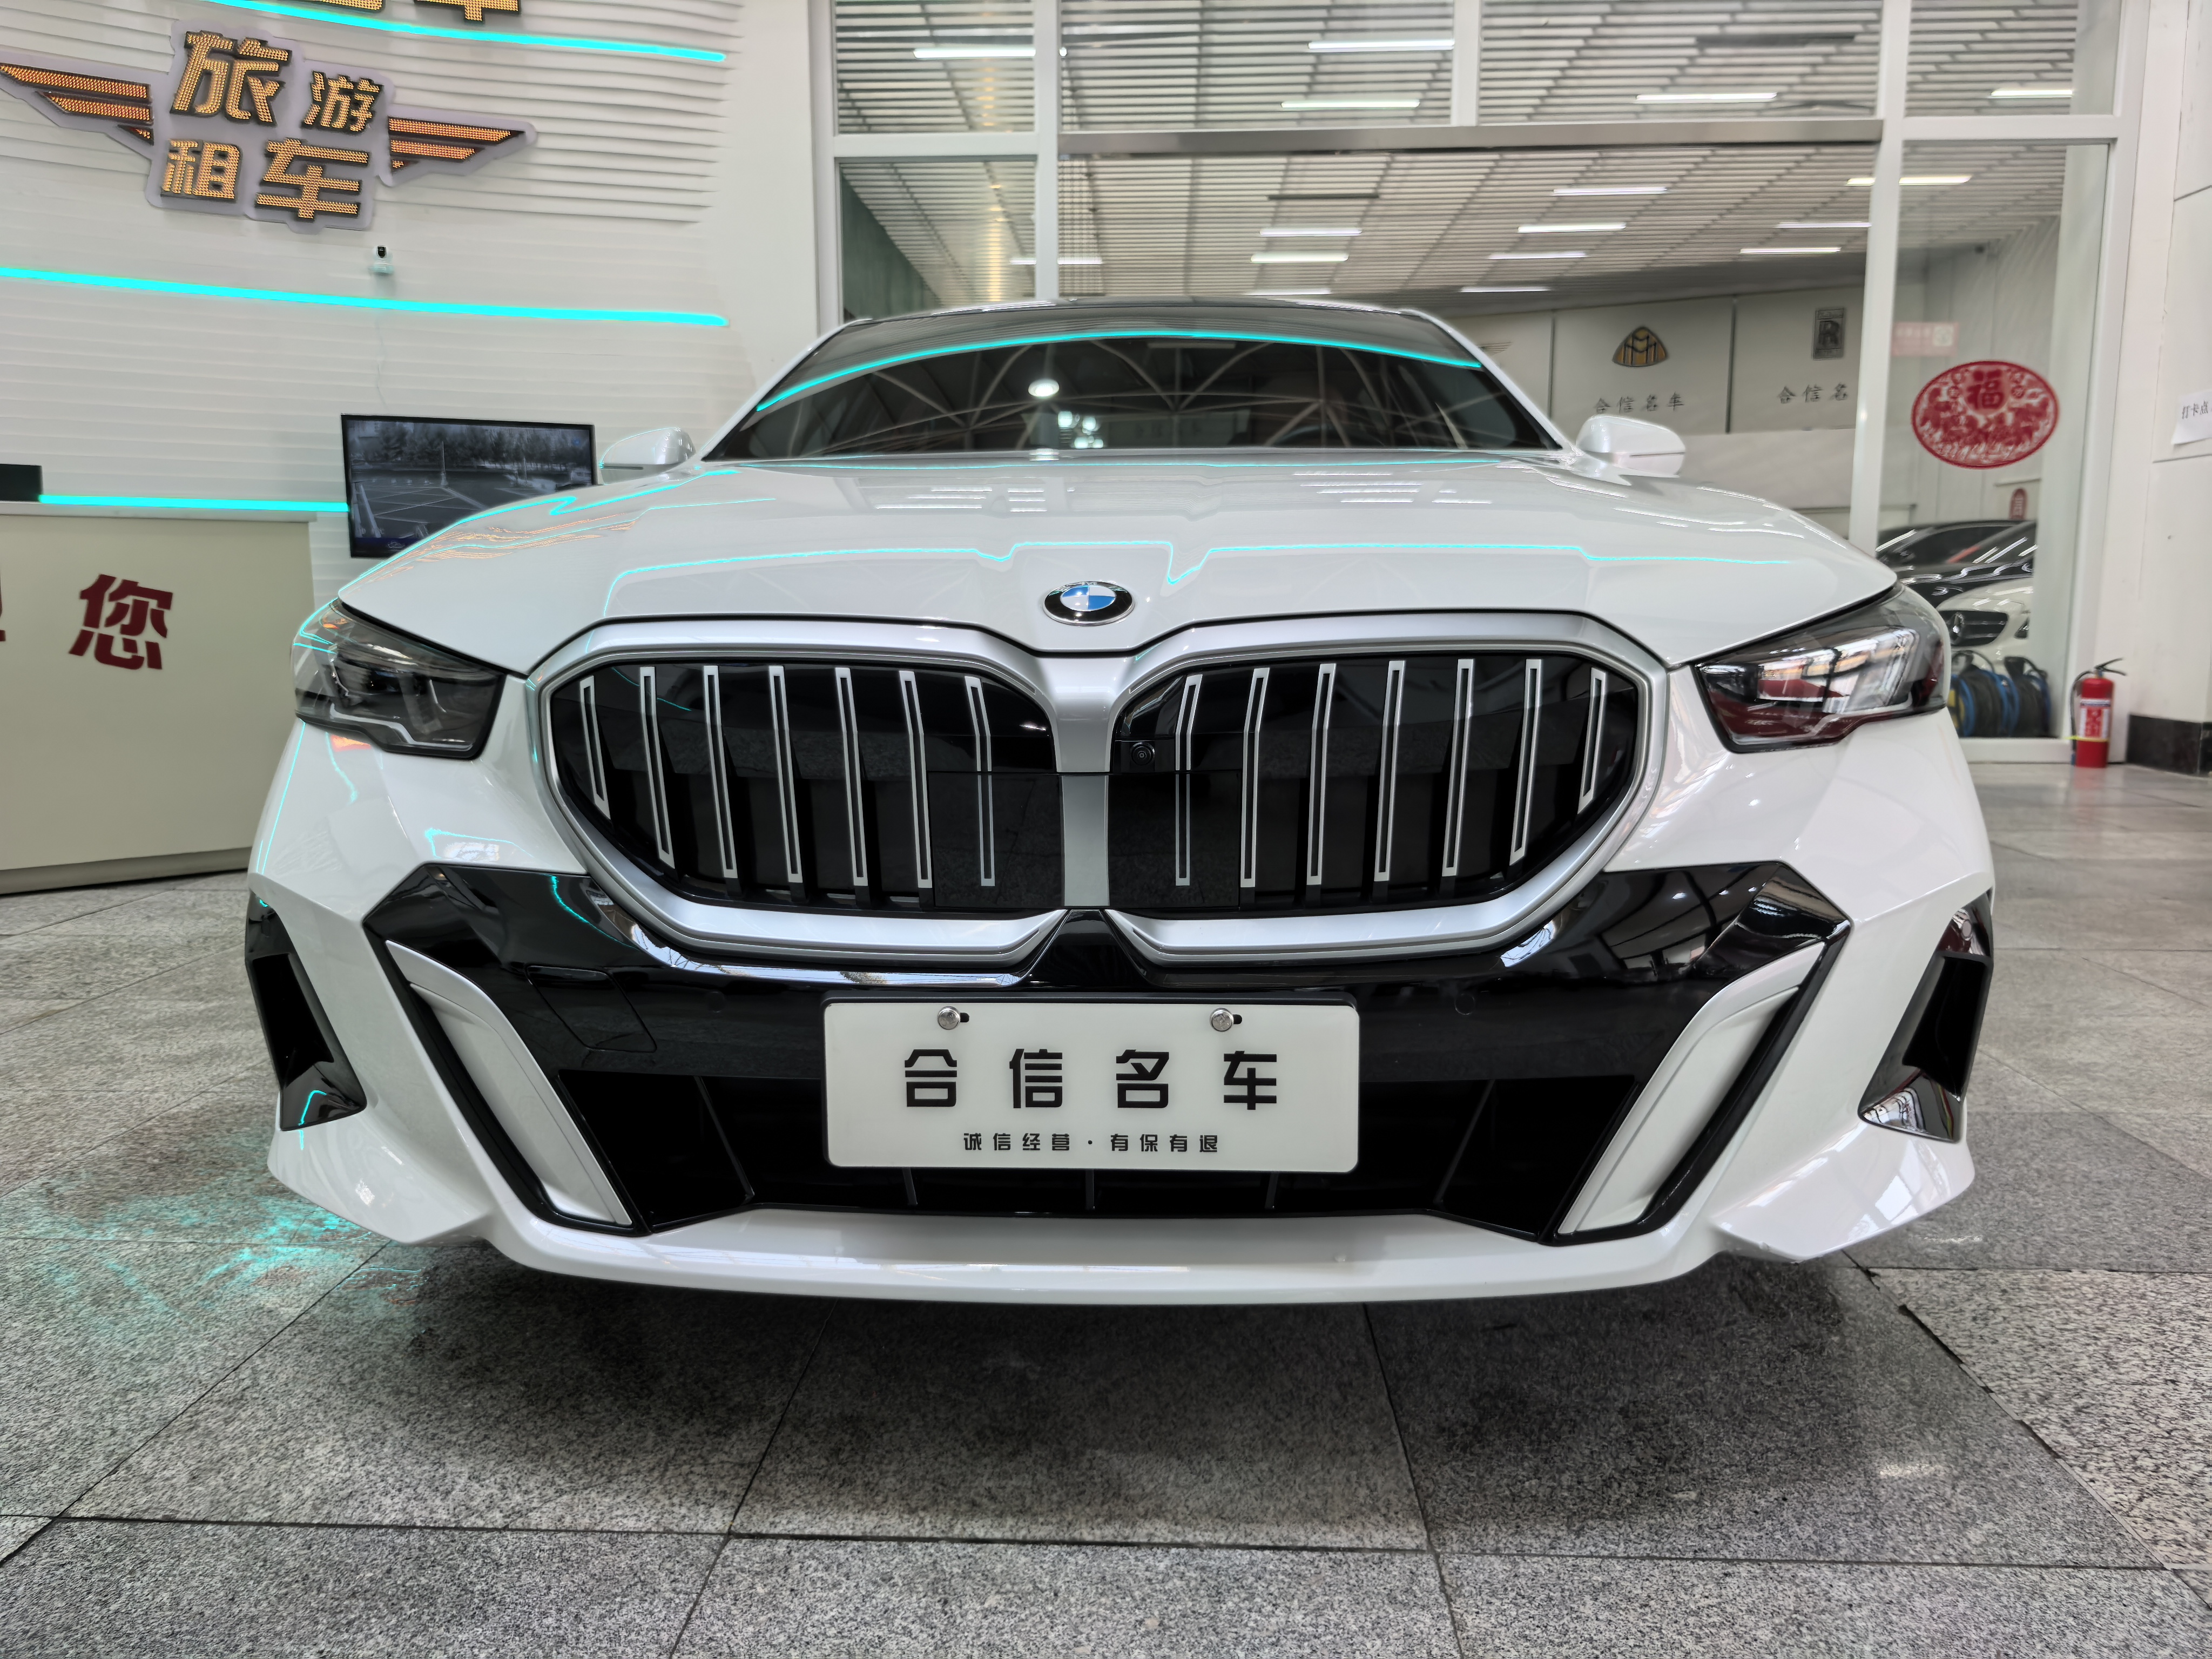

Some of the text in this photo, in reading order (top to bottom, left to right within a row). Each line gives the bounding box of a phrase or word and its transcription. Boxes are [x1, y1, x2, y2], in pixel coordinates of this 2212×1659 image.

[171, 30, 385, 132] 旅游
[161, 138, 371, 219] 租车
[905, 1049, 1277, 1110] 合信名车
[964, 1132, 1218, 1152] 诚信经营·有保有退
